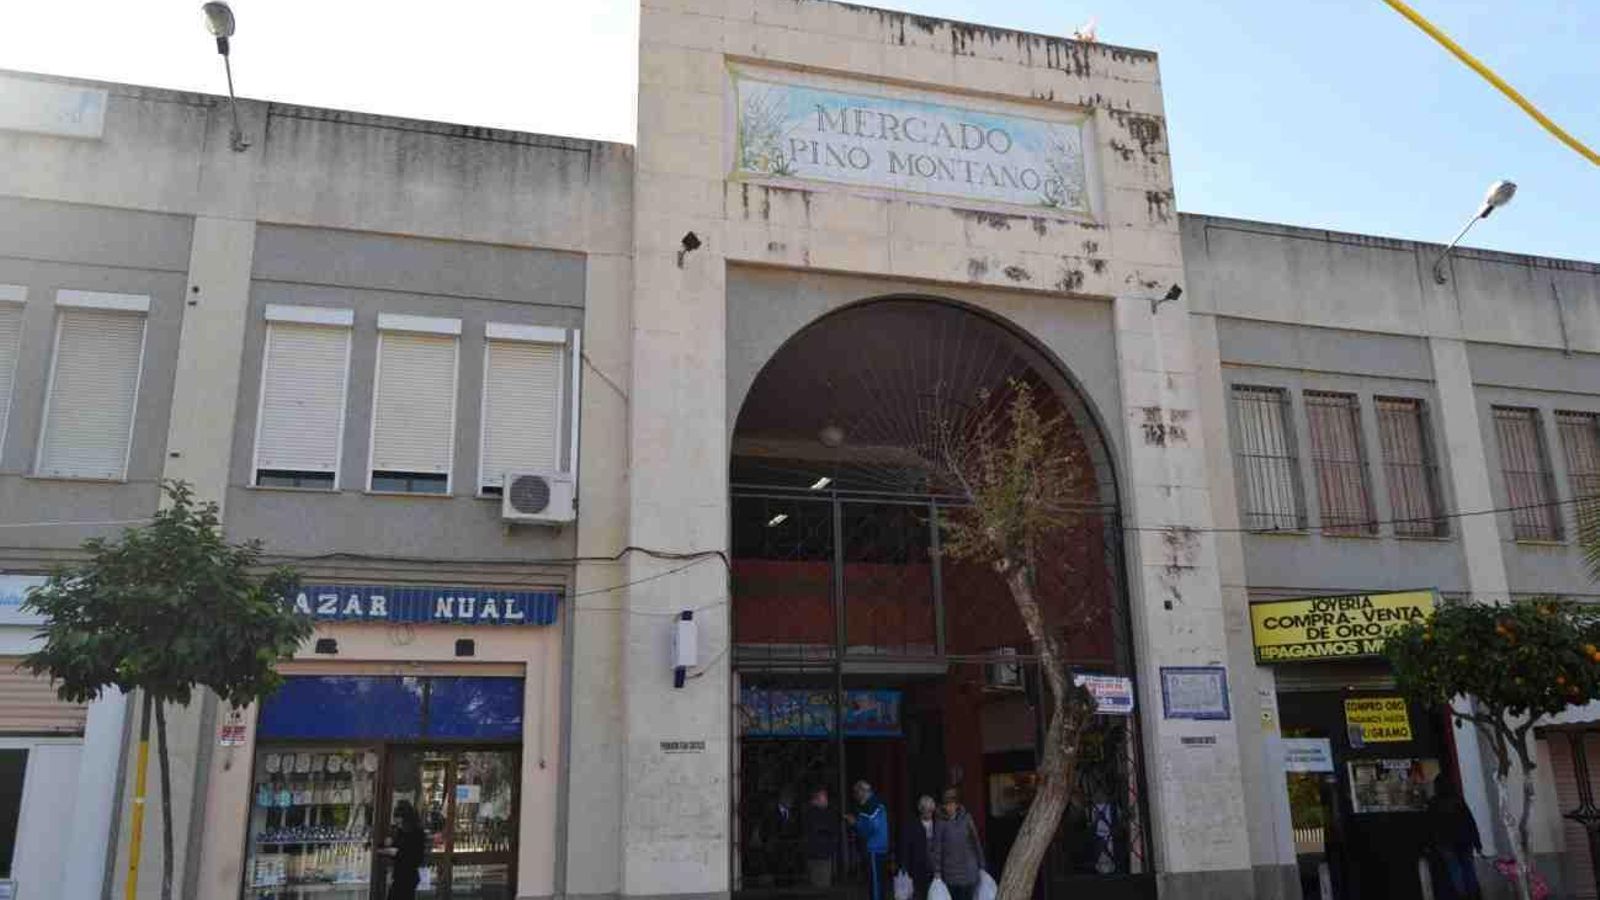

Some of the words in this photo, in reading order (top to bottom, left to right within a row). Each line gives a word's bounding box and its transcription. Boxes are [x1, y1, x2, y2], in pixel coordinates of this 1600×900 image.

[815, 103, 1013, 155] MERCADO
[789, 138, 871, 170] PINO
[888, 151, 1041, 191] MONTANO
[434, 597, 525, 619] NUAL
[1362, 605, 1424, 624] VENTA
[1306, 626, 1331, 640] DE
[1335, 623, 1382, 639] ORO
